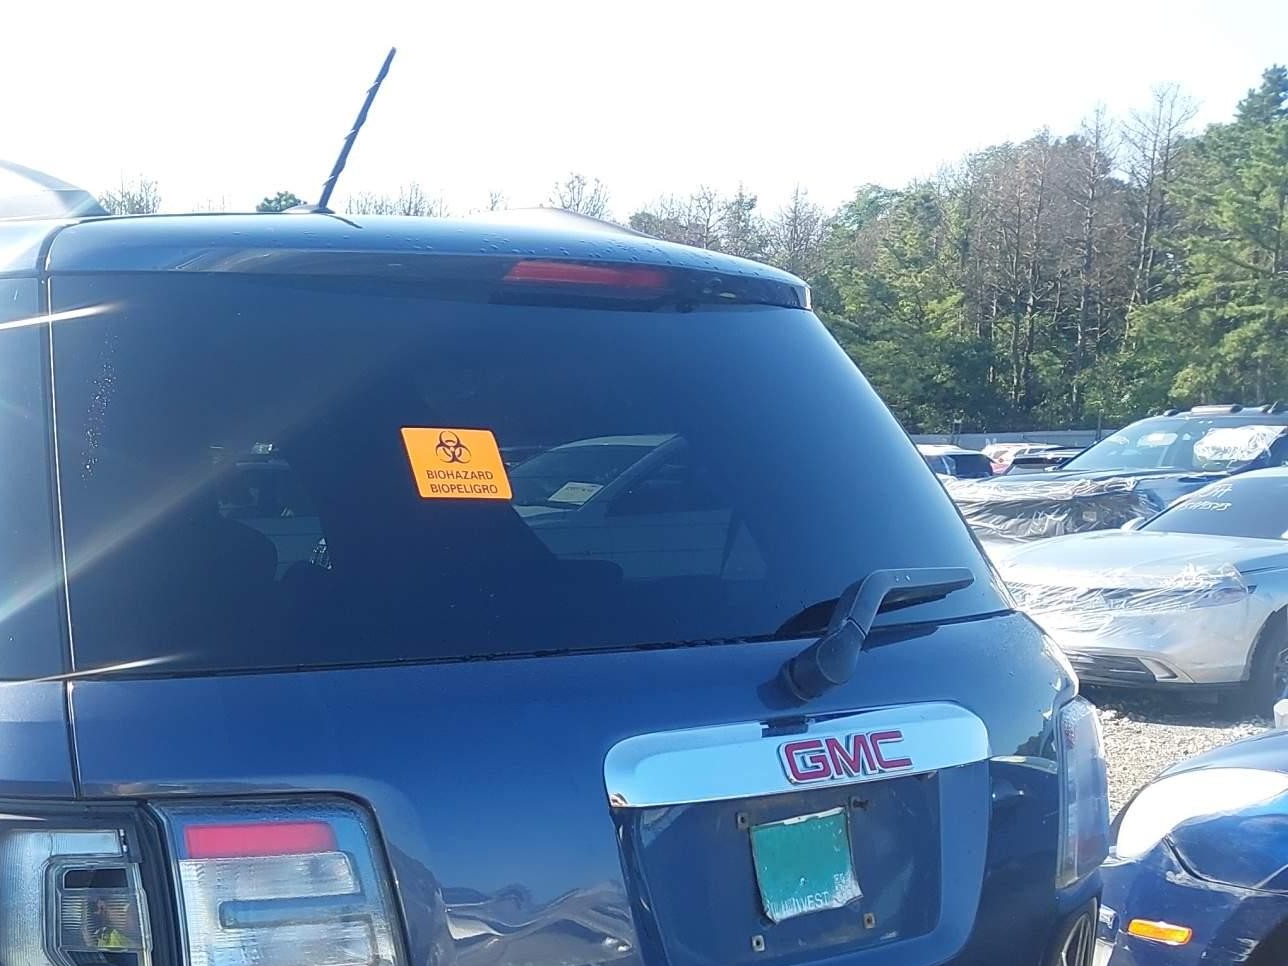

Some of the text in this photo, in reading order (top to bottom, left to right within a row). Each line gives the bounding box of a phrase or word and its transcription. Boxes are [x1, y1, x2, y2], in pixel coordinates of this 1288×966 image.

[426, 470, 493, 480] BIOHAZARD
[430, 484, 498, 494] BIOPELIGRO
[778, 730, 913, 784] GMC
